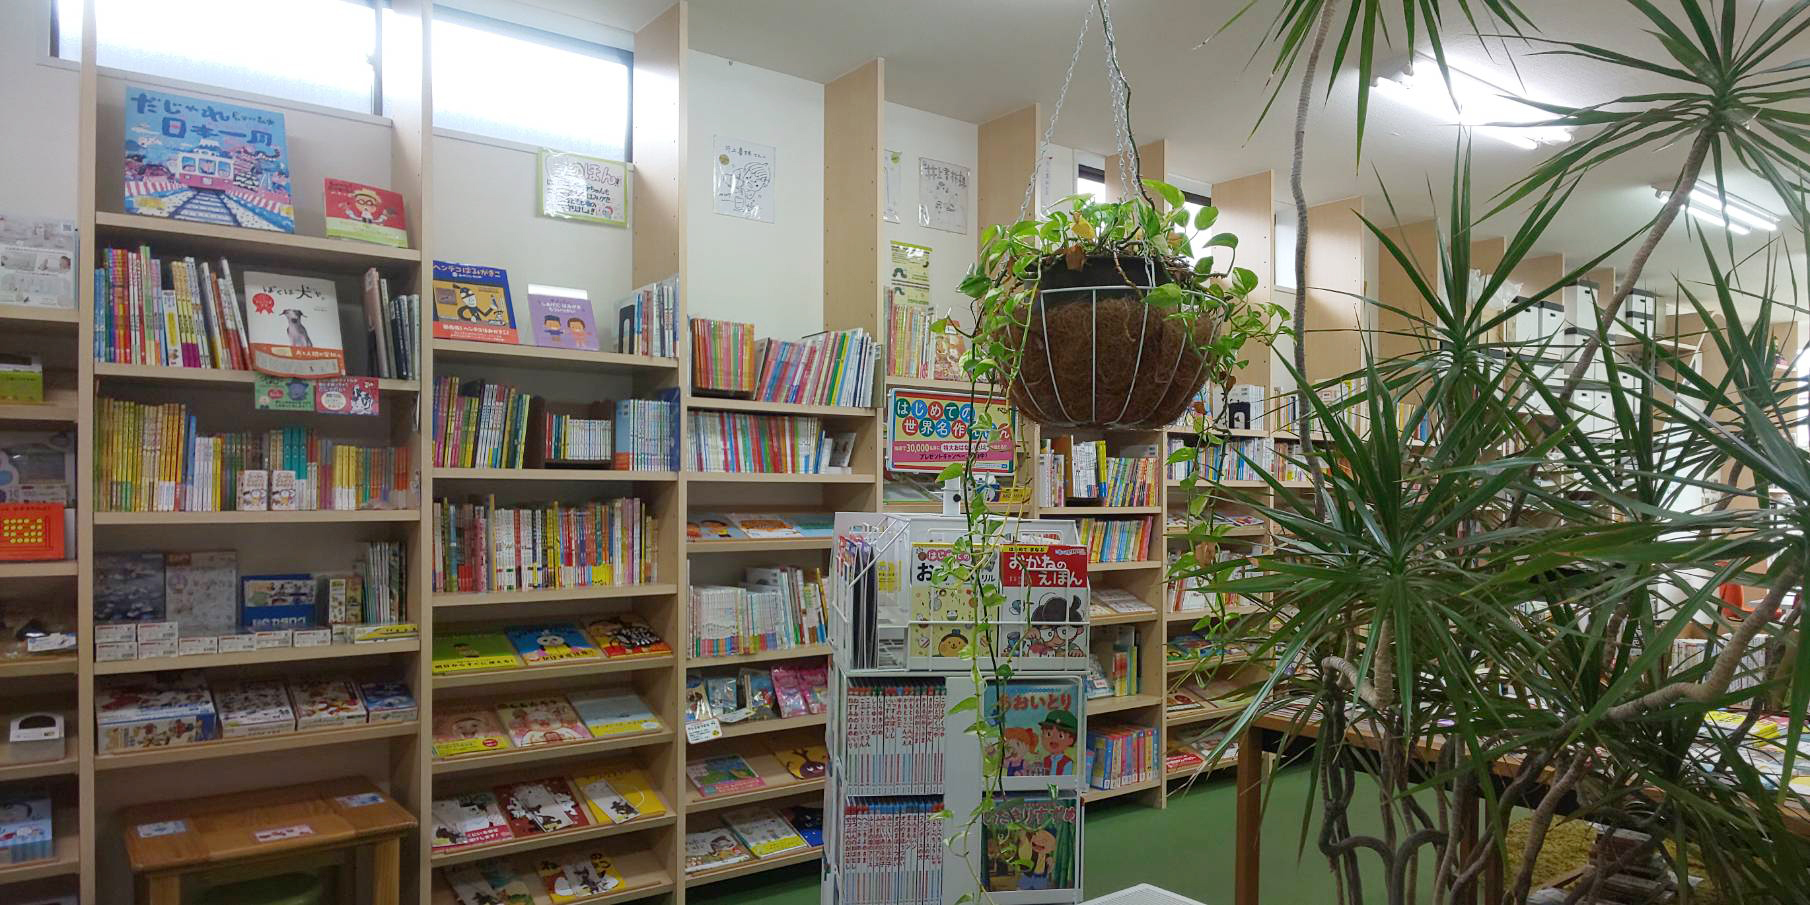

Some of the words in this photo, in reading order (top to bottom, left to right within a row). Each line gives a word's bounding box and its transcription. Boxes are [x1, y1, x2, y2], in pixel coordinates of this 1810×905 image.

[897, 402, 973, 420] はじめての
[1008, 554, 1067, 570] おかねの
[1038, 570, 1083, 586] えほん
